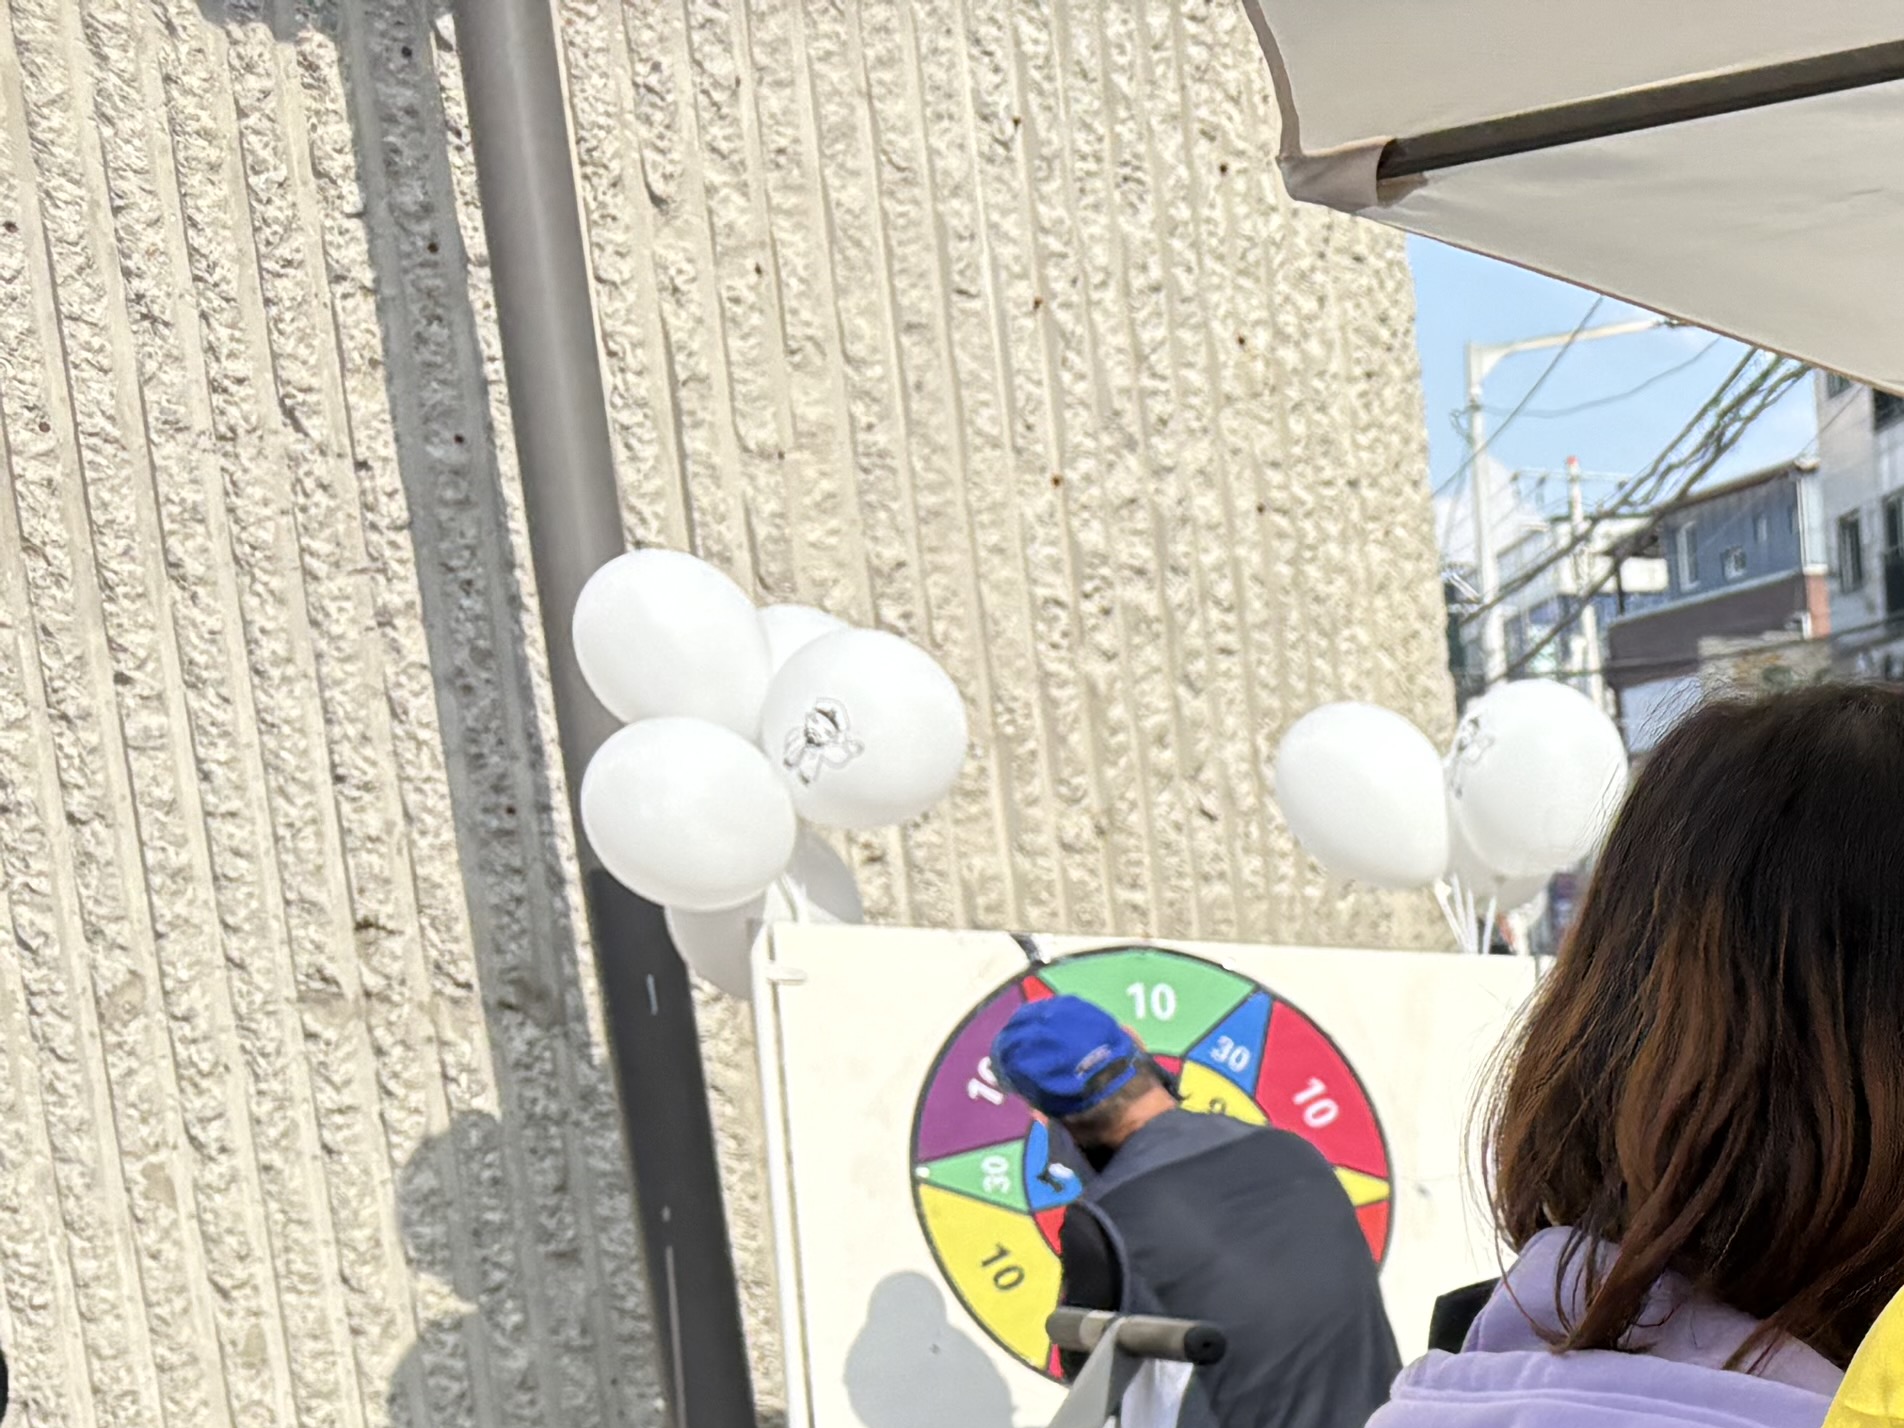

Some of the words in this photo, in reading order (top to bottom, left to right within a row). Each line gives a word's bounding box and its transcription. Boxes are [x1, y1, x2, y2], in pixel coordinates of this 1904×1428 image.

[1125, 982, 1176, 1020] 10
[1209, 1035, 1250, 1072] 30
[1291, 1076, 1340, 1129] 10
[980, 1155, 1010, 1194] 30
[979, 1242, 1026, 1294] 10
